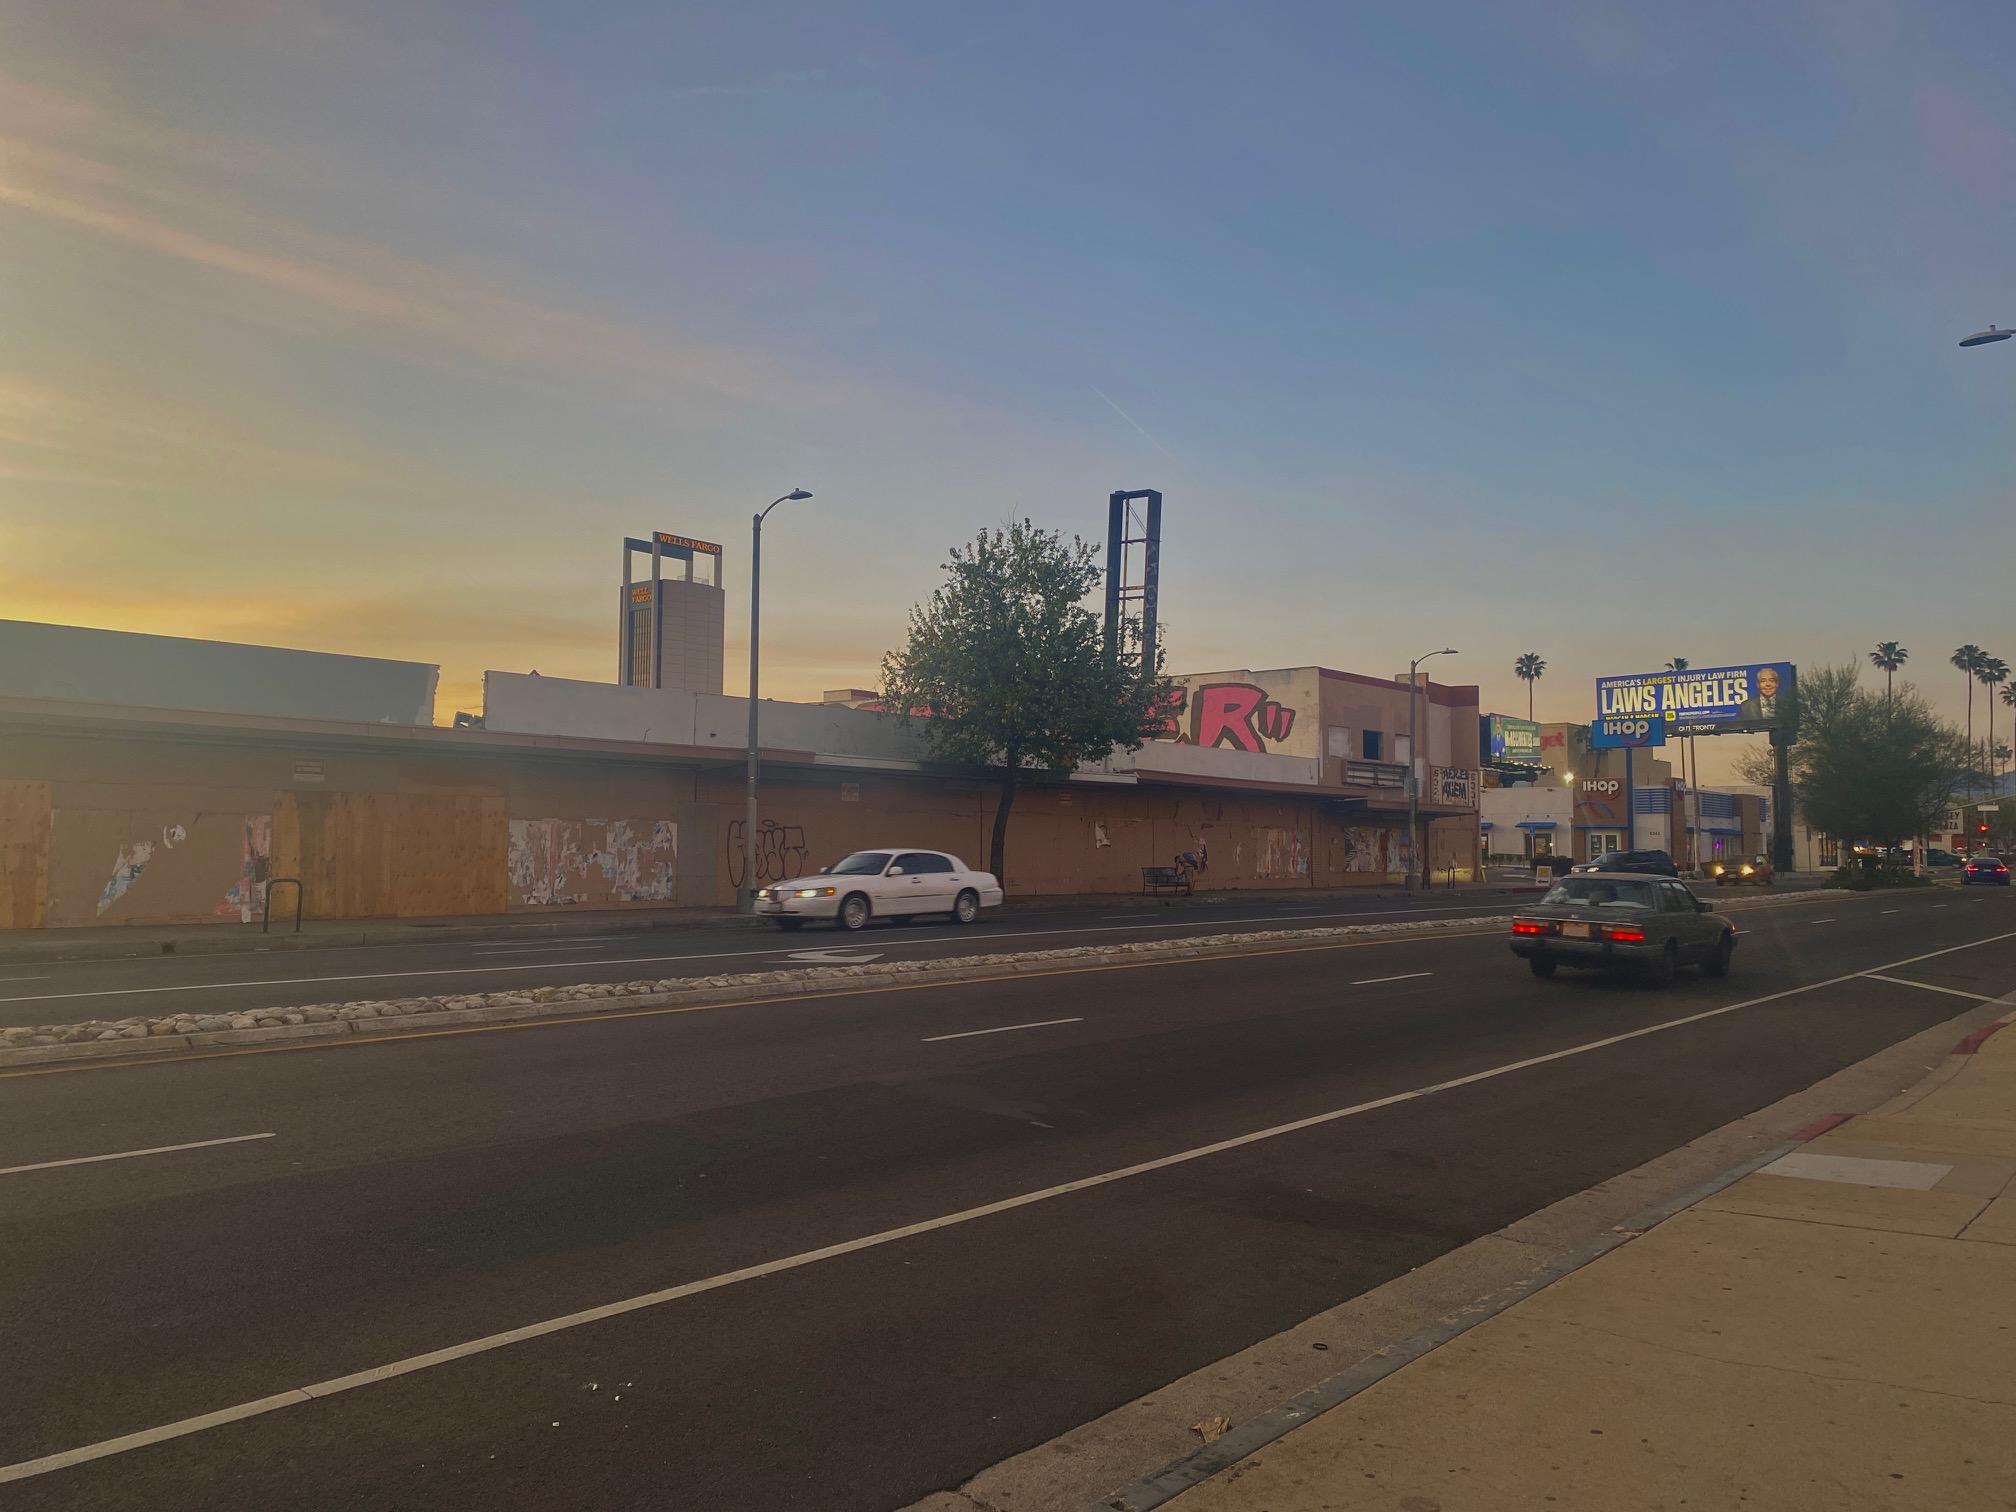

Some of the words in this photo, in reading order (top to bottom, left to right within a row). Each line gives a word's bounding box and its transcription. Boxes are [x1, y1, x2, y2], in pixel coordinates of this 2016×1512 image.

[658, 534, 690, 547] WELLS
[691, 541, 720, 554] FARGO
[631, 588, 651, 596] WELLS
[632, 595, 652, 603] FARGO
[1601, 678, 1642, 689] AMERICA'S
[1642, 676, 1676, 686] LARGEST
[1677, 673, 1706, 683] INJURY
[1707, 672, 1726, 681] LAW
[1726, 669, 1747, 678] FIRM
[1601, 685, 1656, 714] LAWS
[1661, 678, 1748, 710] ANGELES
[1603, 721, 1649, 738] IHOP
[1582, 780, 1619, 795] IHOP
